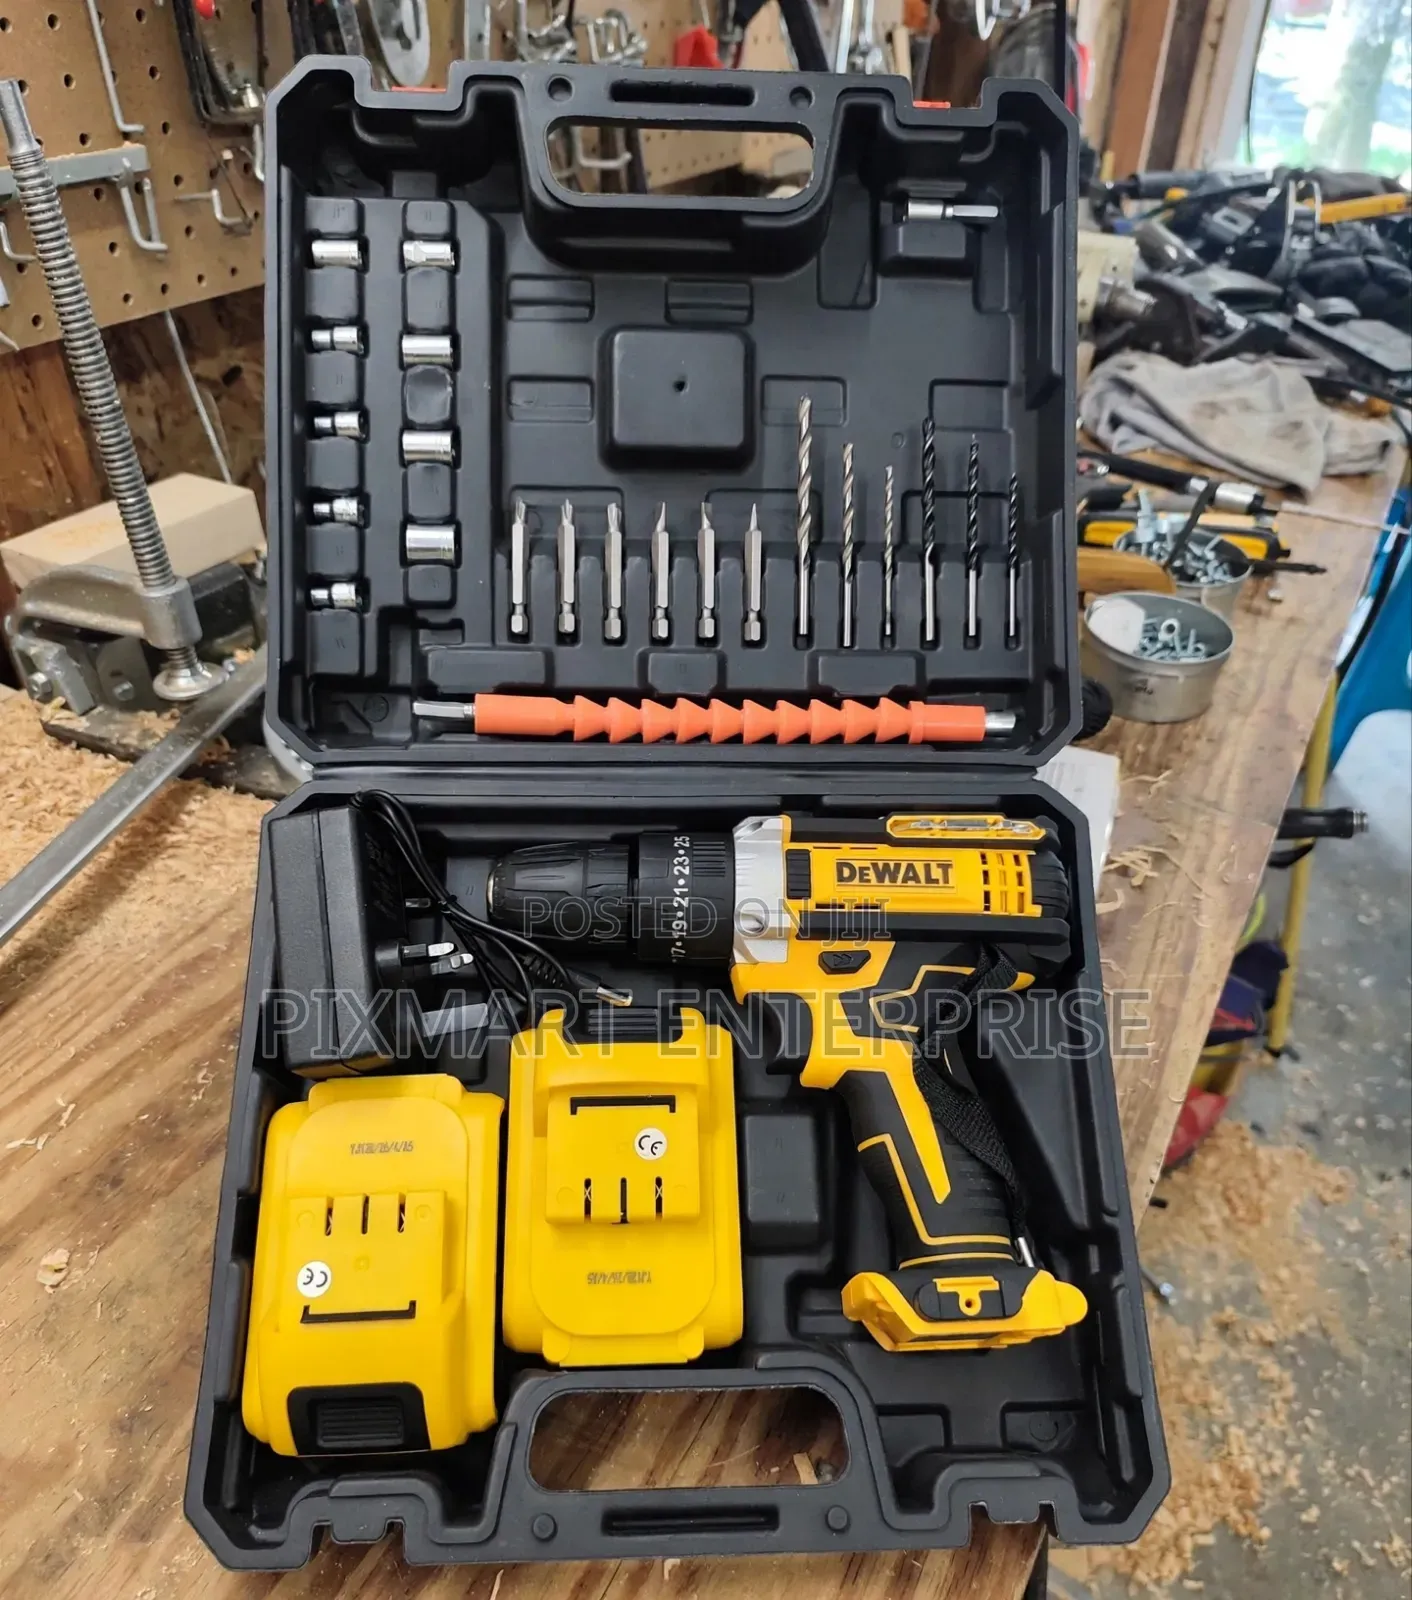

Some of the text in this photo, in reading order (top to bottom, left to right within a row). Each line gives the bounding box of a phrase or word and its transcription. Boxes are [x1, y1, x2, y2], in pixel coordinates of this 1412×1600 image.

[673, 836, 690, 848] 25
[673, 856, 690, 875] 23
[673, 888, 689, 908] 21
[672, 920, 688, 939] 19
